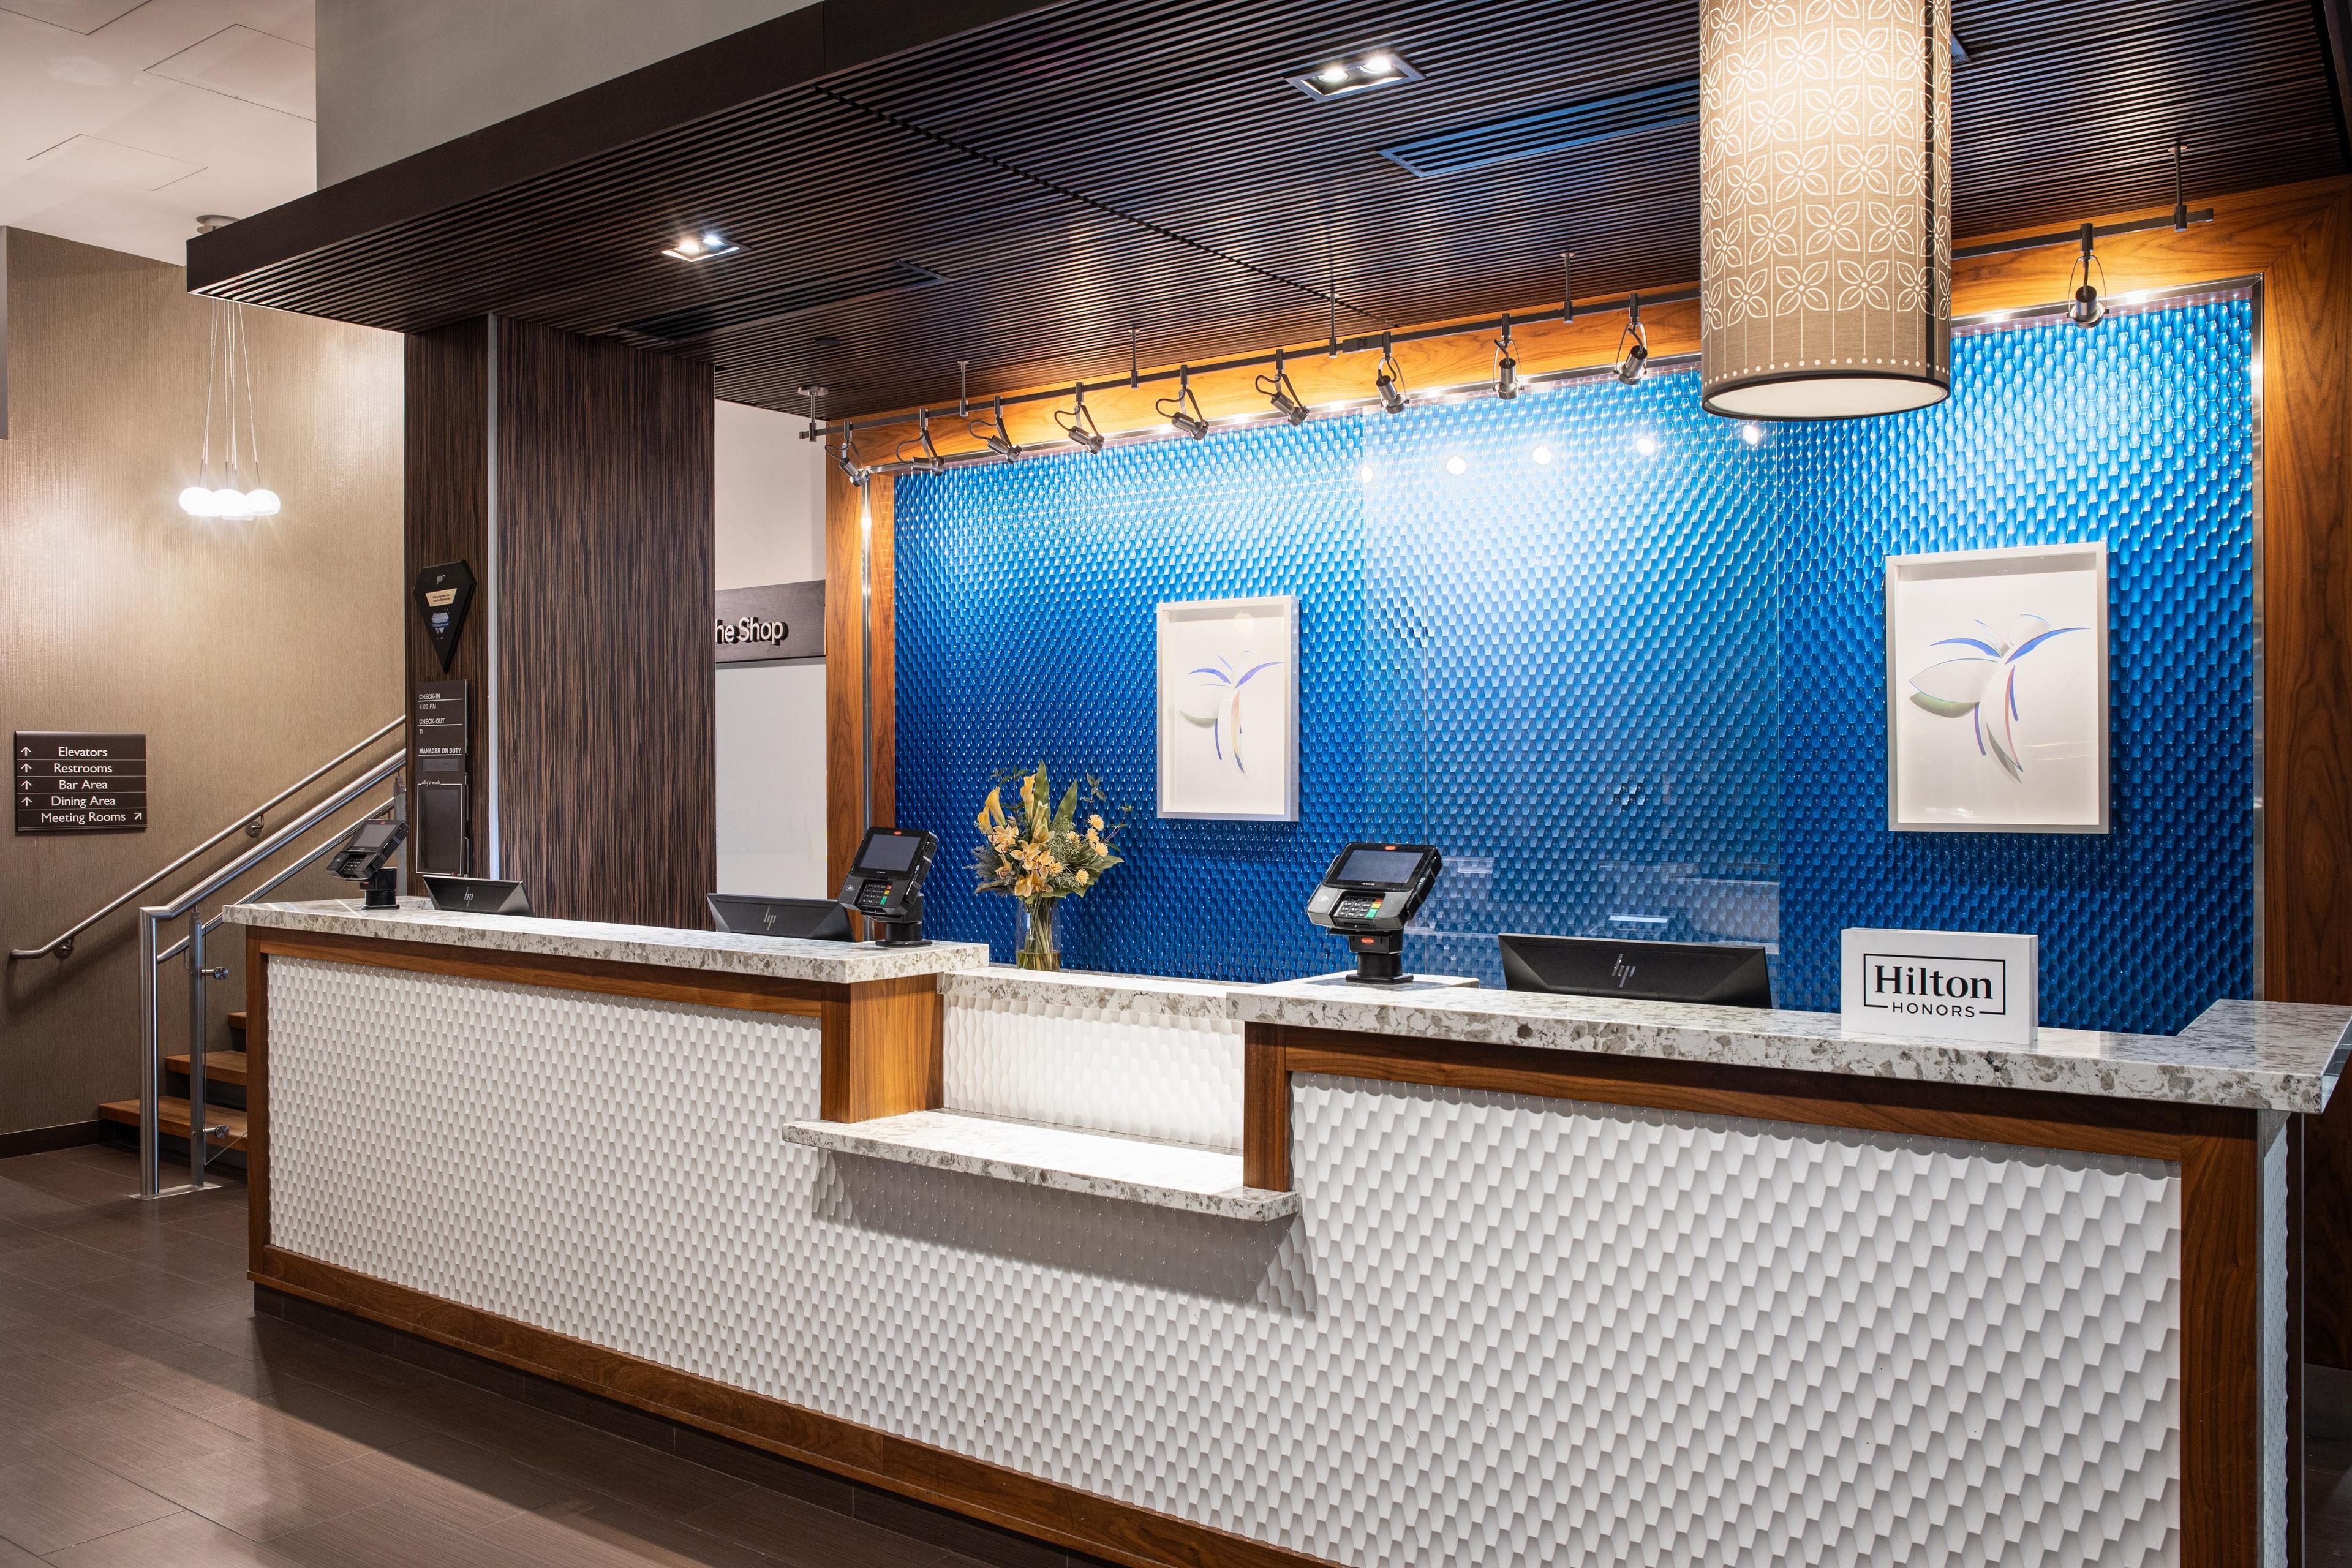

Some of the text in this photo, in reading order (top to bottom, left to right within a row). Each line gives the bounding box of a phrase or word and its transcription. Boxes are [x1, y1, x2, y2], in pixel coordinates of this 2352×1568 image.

[715, 616, 784, 645] he Shop
[58, 747, 108, 757] Elevators
[54, 763, 113, 773] Restrooms
[59, 779, 108, 790] Bar Area
[51, 796, 116, 809] Dining Area
[41, 812, 126, 825] Meeting Rooms
[1875, 965, 1993, 1000] Hilton
[1893, 1001, 1975, 1018] HONORS
